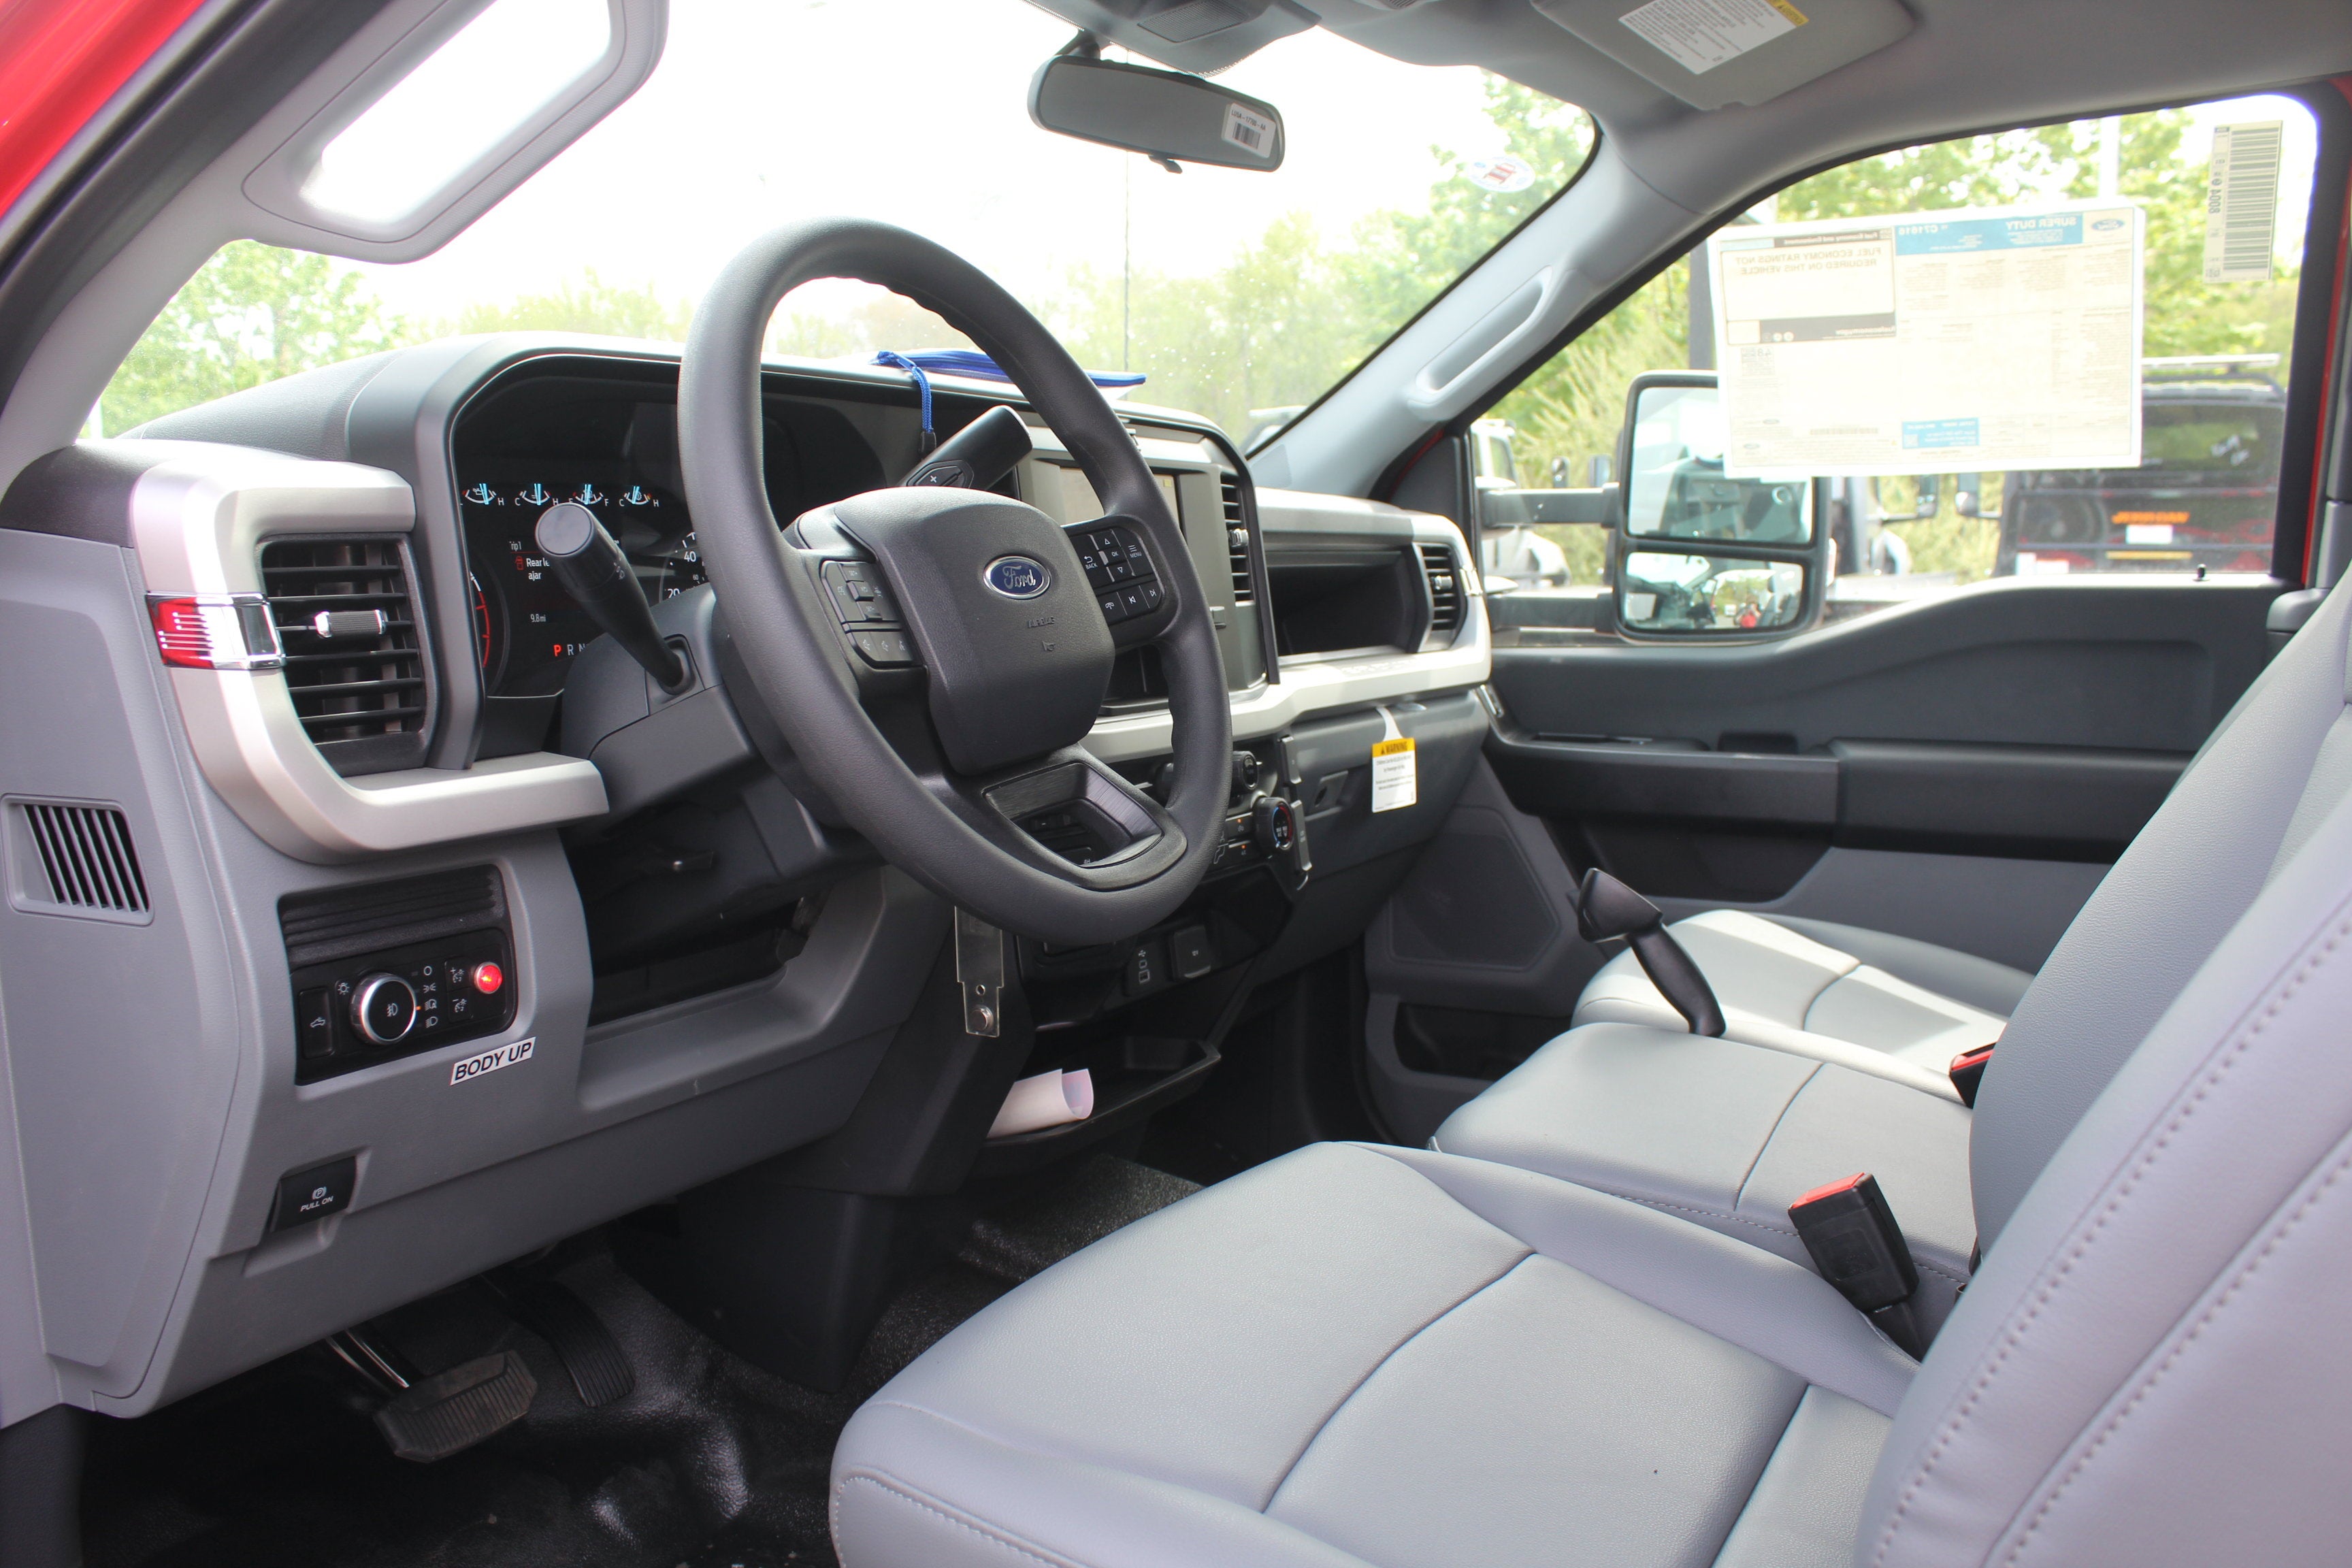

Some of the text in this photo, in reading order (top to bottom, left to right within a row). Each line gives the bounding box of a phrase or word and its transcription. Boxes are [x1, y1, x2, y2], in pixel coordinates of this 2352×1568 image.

[497, 497, 505, 506] H
[514, 497, 521, 506] C
[604, 498, 610, 506] F
[619, 498, 659, 508] C H
[683, 551, 697, 562] 40
[526, 558, 542, 568] Rear
[528, 571, 542, 581] ajar
[1002, 565, 1036, 589] Ford
[1028, 617, 1056, 628] AIRBAG
[553, 643, 563, 657] P
[567, 644, 575, 656] R
[454, 1042, 533, 1081] BODY UP
[299, 1195, 334, 1213] PULL ON
